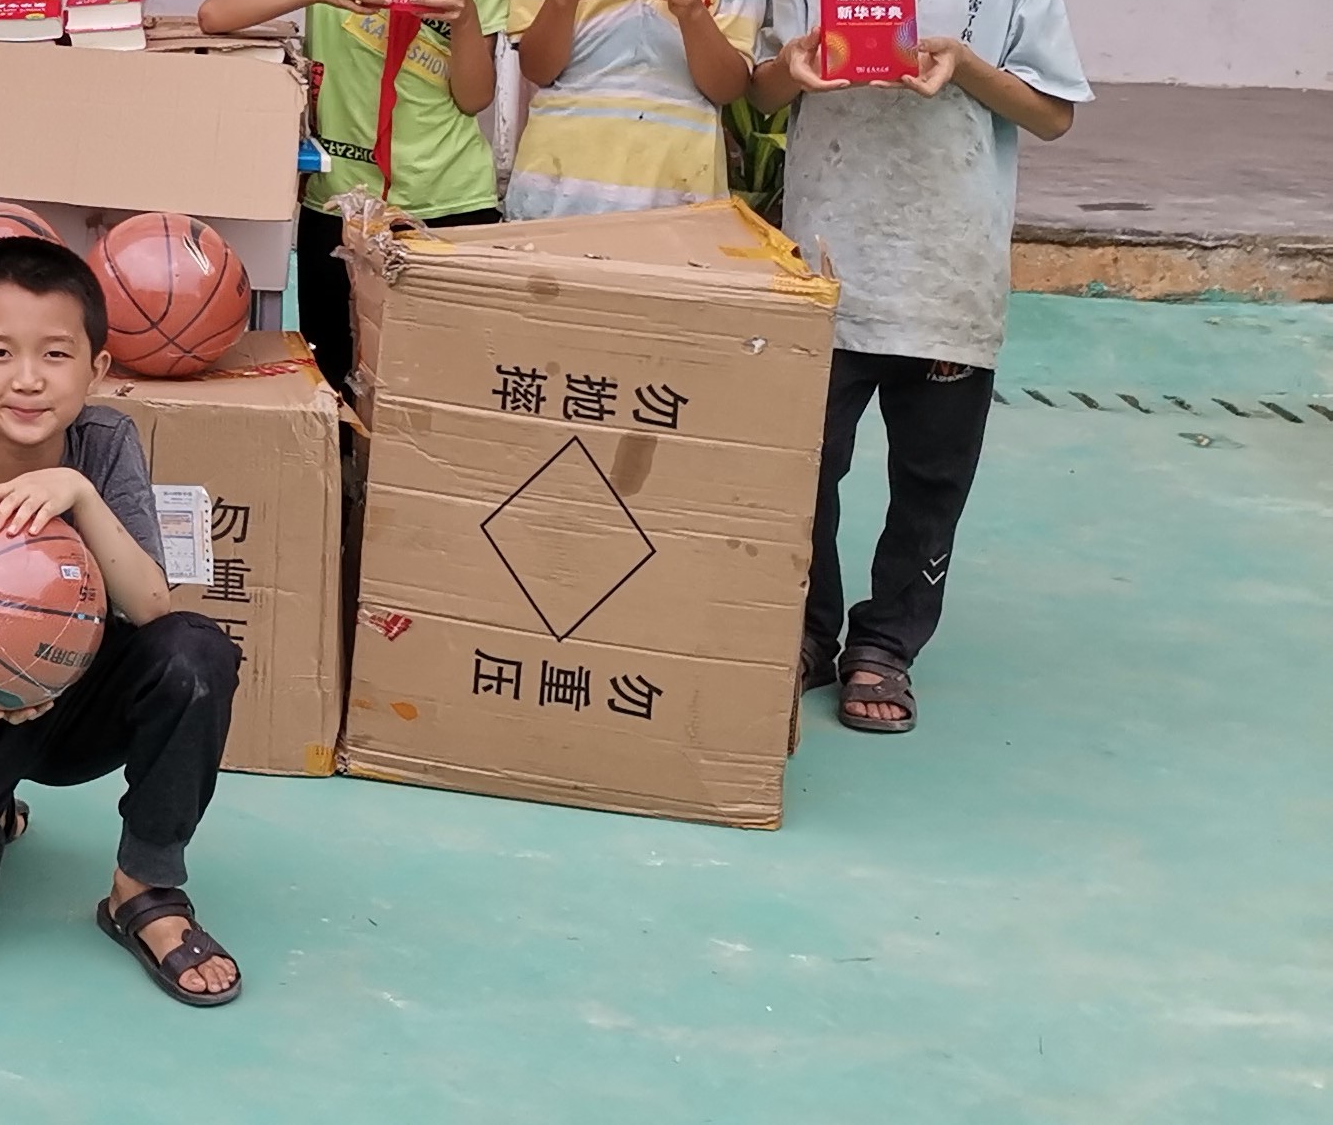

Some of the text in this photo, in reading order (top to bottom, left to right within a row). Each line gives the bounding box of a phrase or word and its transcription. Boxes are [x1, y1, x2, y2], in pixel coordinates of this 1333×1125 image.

[836, 5, 903, 20] 新华字典
[491, 364, 690, 430] 勿抛摔
[473, 648, 665, 722] 勿重压
